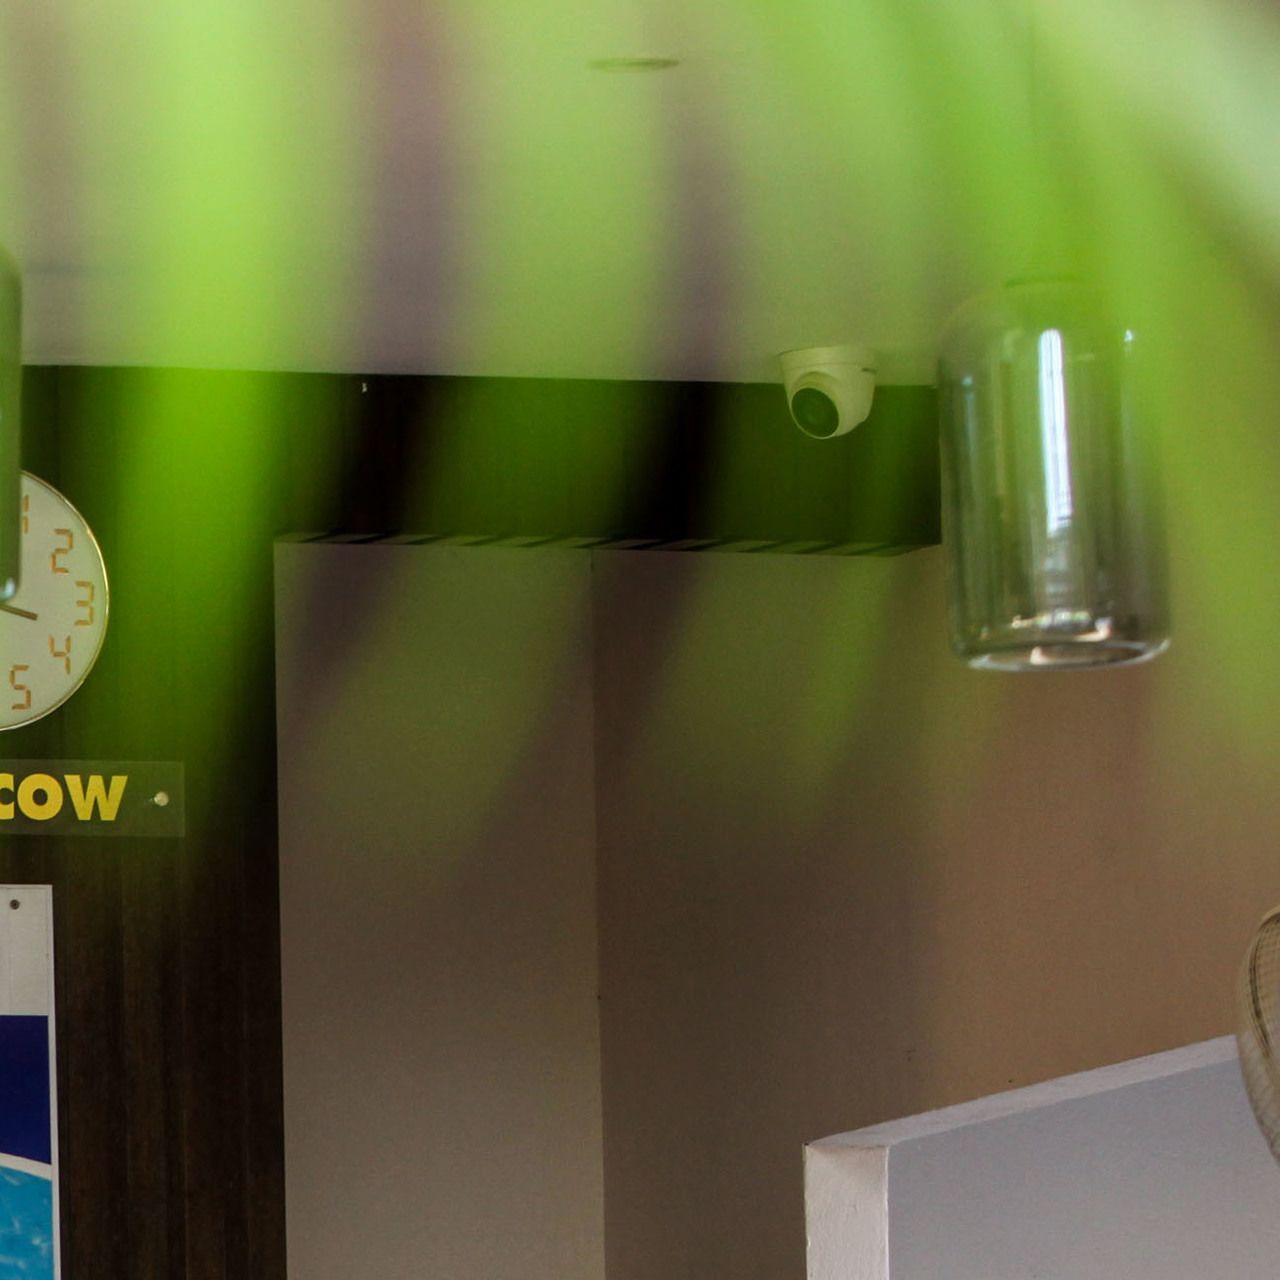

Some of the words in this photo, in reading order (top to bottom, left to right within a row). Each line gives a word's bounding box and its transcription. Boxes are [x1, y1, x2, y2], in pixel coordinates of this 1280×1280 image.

[51, 528, 73, 574] 2
[74, 580, 95, 627] 3
[48, 635, 71, 675] 4
[9, 664, 32, 711] 5
